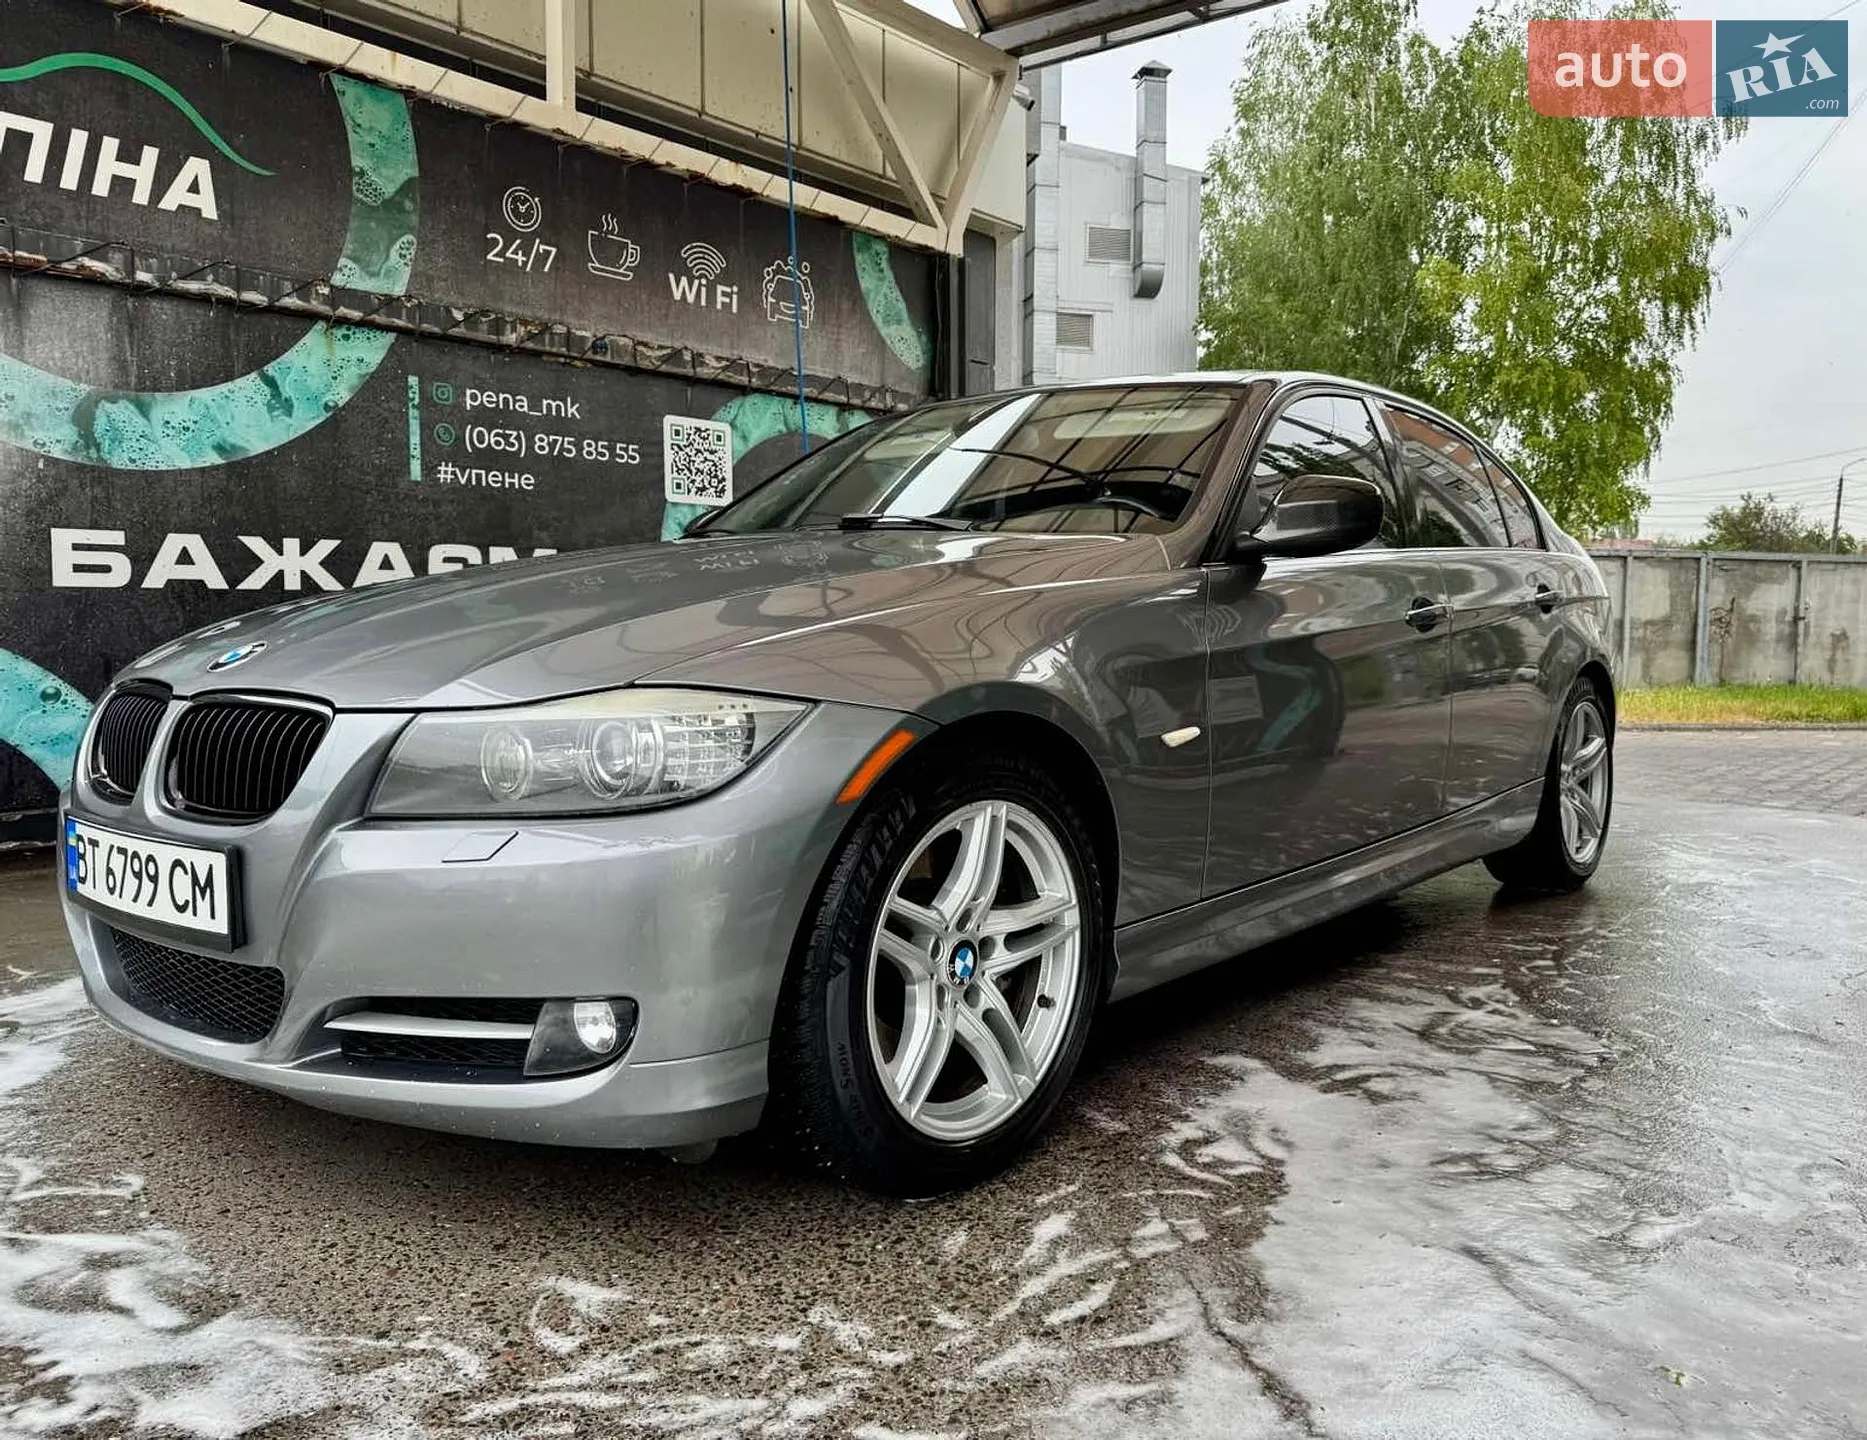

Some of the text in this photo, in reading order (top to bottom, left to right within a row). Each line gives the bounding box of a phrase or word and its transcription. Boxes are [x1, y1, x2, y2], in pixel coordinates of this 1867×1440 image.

[486, 233, 558, 272] 24/7
[668, 272, 739, 313] Wi Fi
[466, 388, 581, 419] pena_mk
[465, 424, 641, 465] (063) 875 85 55
[437, 462, 535, 490] #vпене
[77, 834, 216, 920] BT 6799 CM
